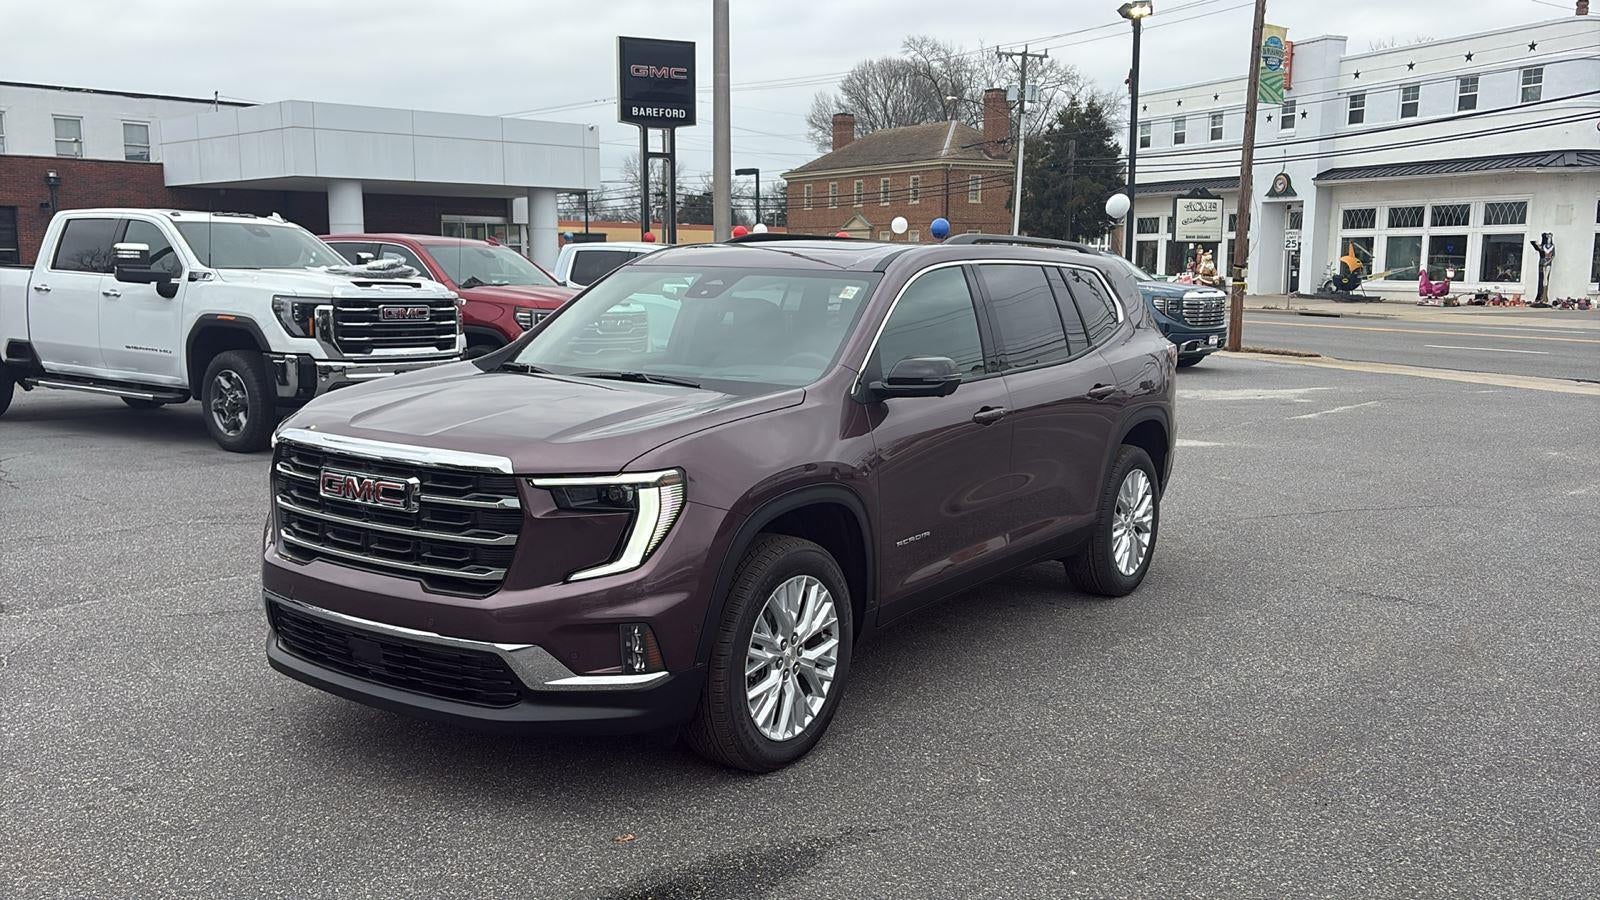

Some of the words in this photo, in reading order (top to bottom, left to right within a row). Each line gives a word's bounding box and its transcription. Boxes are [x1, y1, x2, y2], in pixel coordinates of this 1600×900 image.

[630, 64, 688, 79] GMC
[632, 106, 686, 118] BAREFORD
[1285, 239, 1297, 248] 25
[383, 307, 428, 319] GMC
[320, 471, 406, 507] GMC
[896, 531, 931, 547] ACADIA
